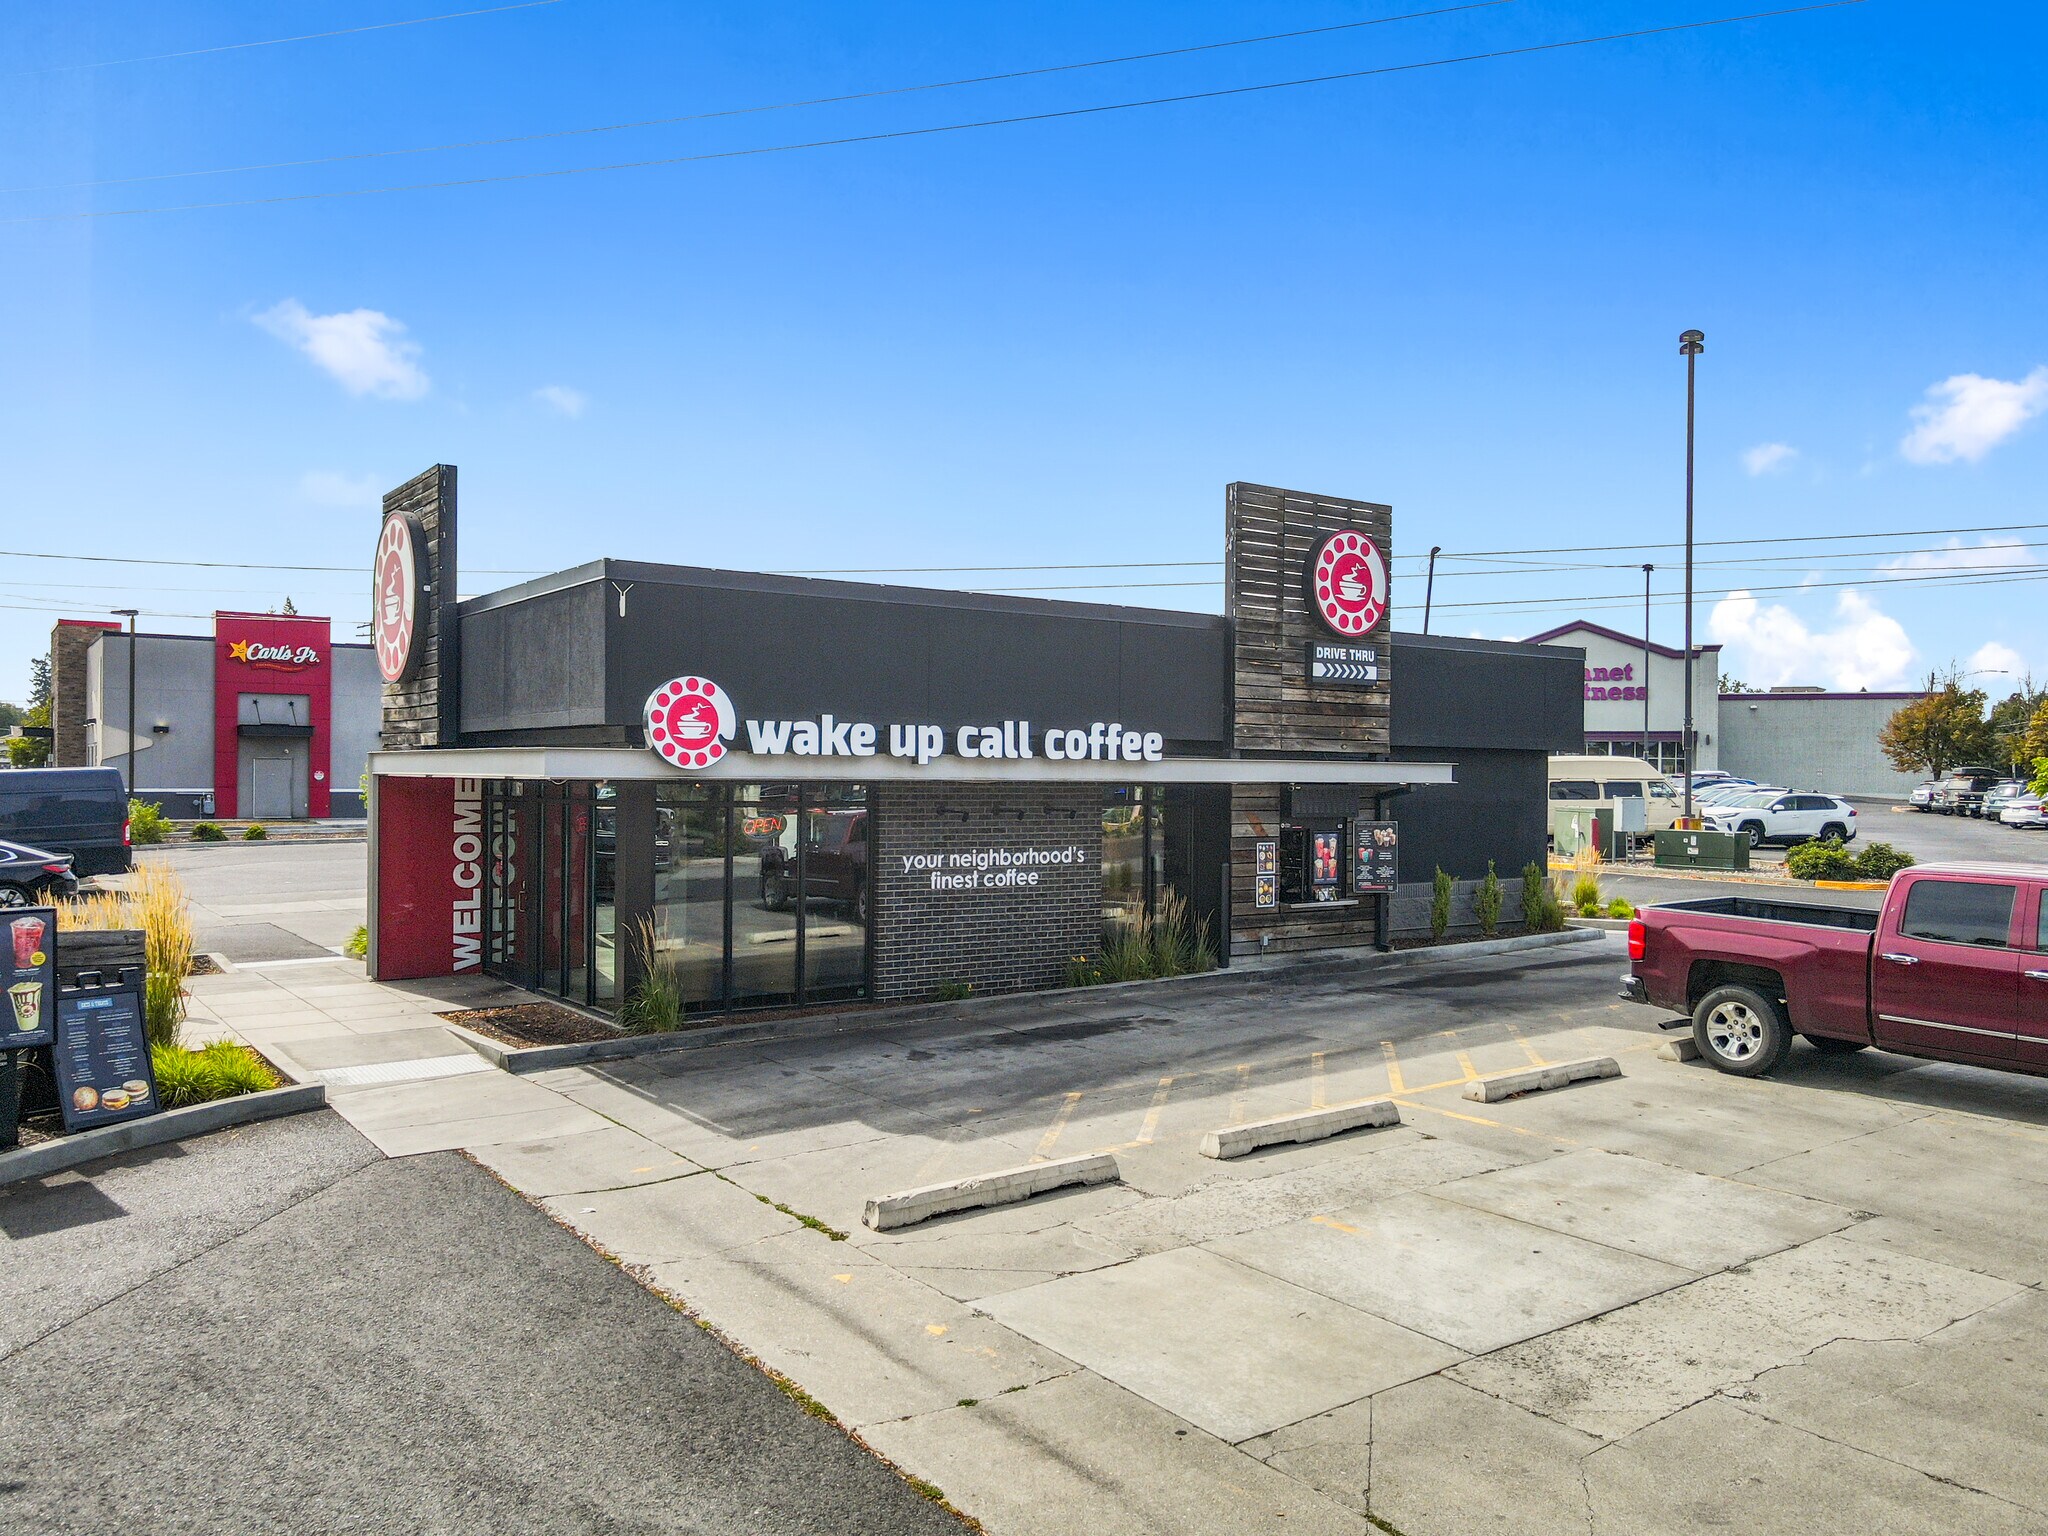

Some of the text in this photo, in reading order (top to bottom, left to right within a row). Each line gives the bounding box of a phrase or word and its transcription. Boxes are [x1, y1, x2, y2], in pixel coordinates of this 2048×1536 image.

[247, 643, 320, 663] Carl's Jr.
[1316, 646, 1375, 662] DRIVE THRU
[745, 714, 1163, 765] wake up call coffee
[744, 817, 782, 835] OPEN
[902, 846, 1085, 874] your neighborhood's
[453, 778, 482, 971] WELCOME
[930, 868, 1039, 890] finest coffee
